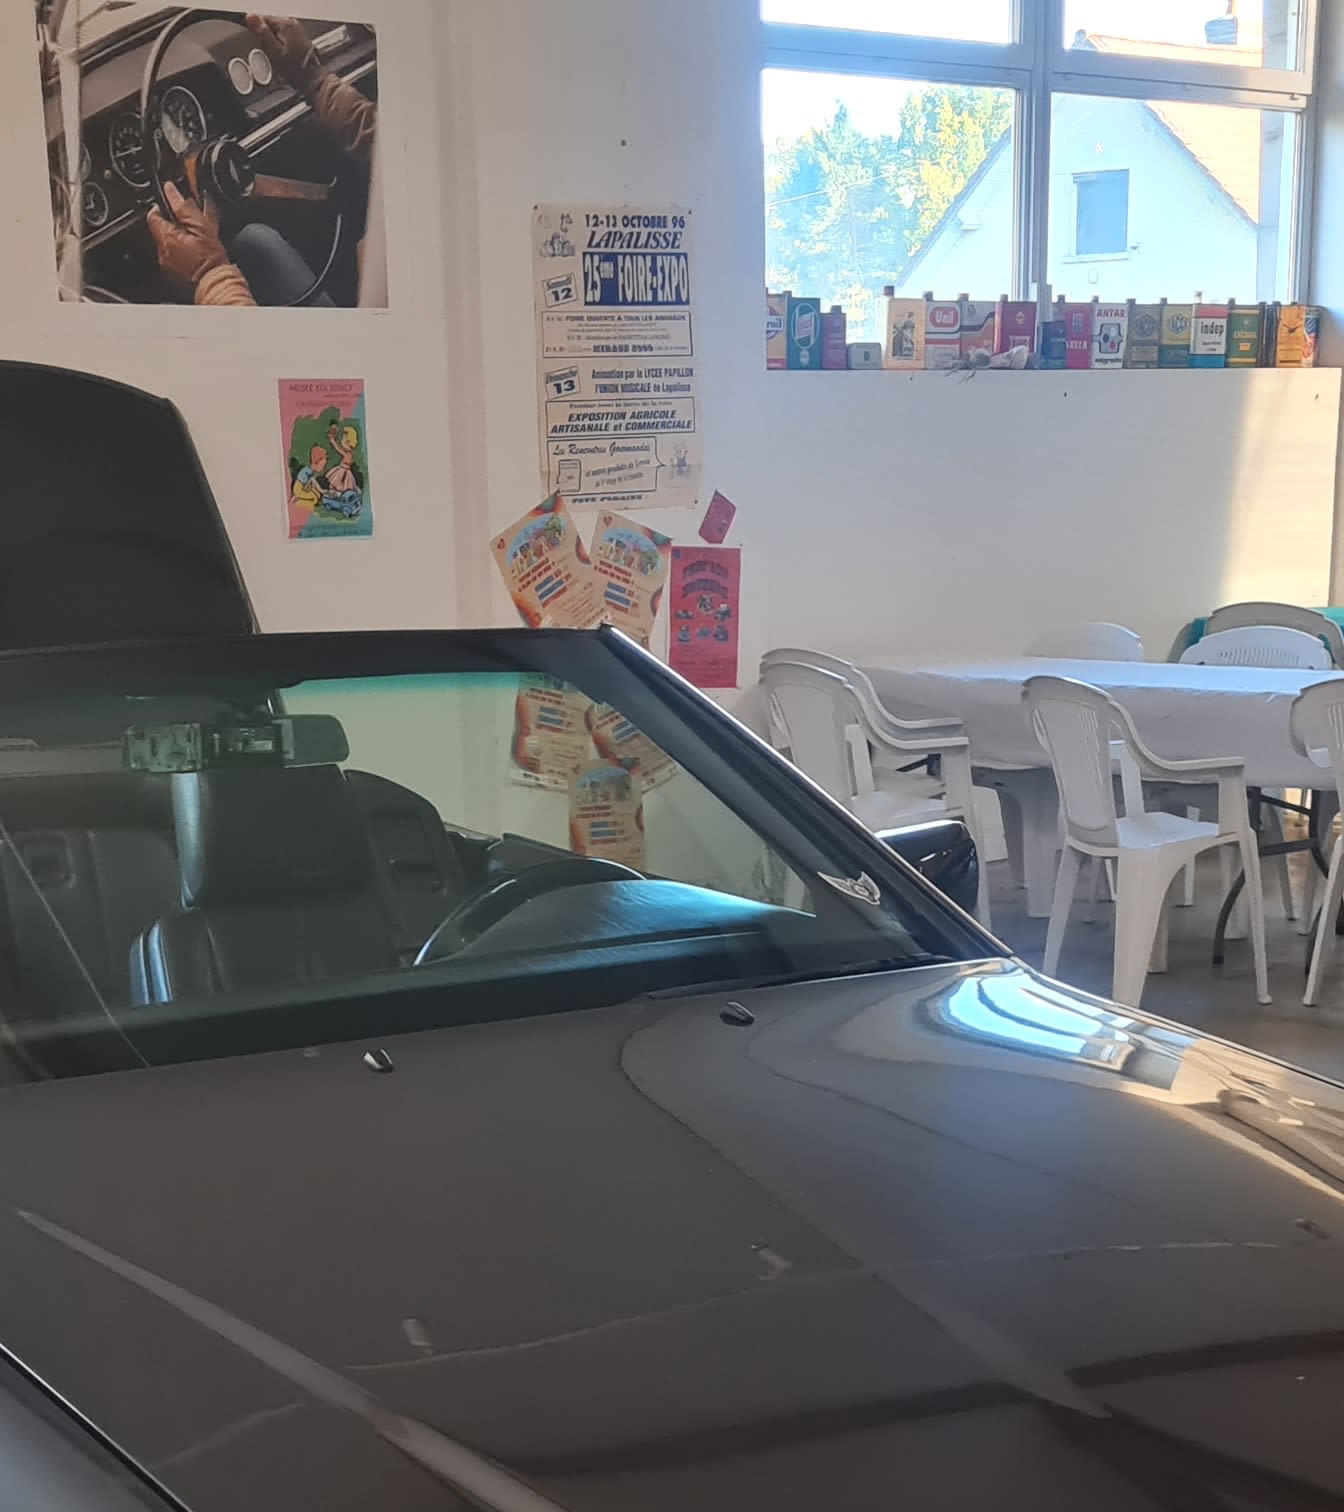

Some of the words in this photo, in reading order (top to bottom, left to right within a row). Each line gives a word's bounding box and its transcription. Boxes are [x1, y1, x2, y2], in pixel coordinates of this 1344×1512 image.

[585, 214, 618, 229] 12-13
[621, 215, 668, 229] OCTOBRE
[672, 215, 686, 229] 96
[586, 230, 683, 250] LAPALISSE
[551, 287, 573, 302] 12
[1096, 308, 1126, 318] ANTAR
[553, 380, 576, 394] 13
[568, 412, 627, 423] EXPOSITION
[630, 410, 677, 420] AGRICOLE
[550, 423, 611, 434] ARTISANALE
[625, 420, 693, 431] COMMERCIALE
